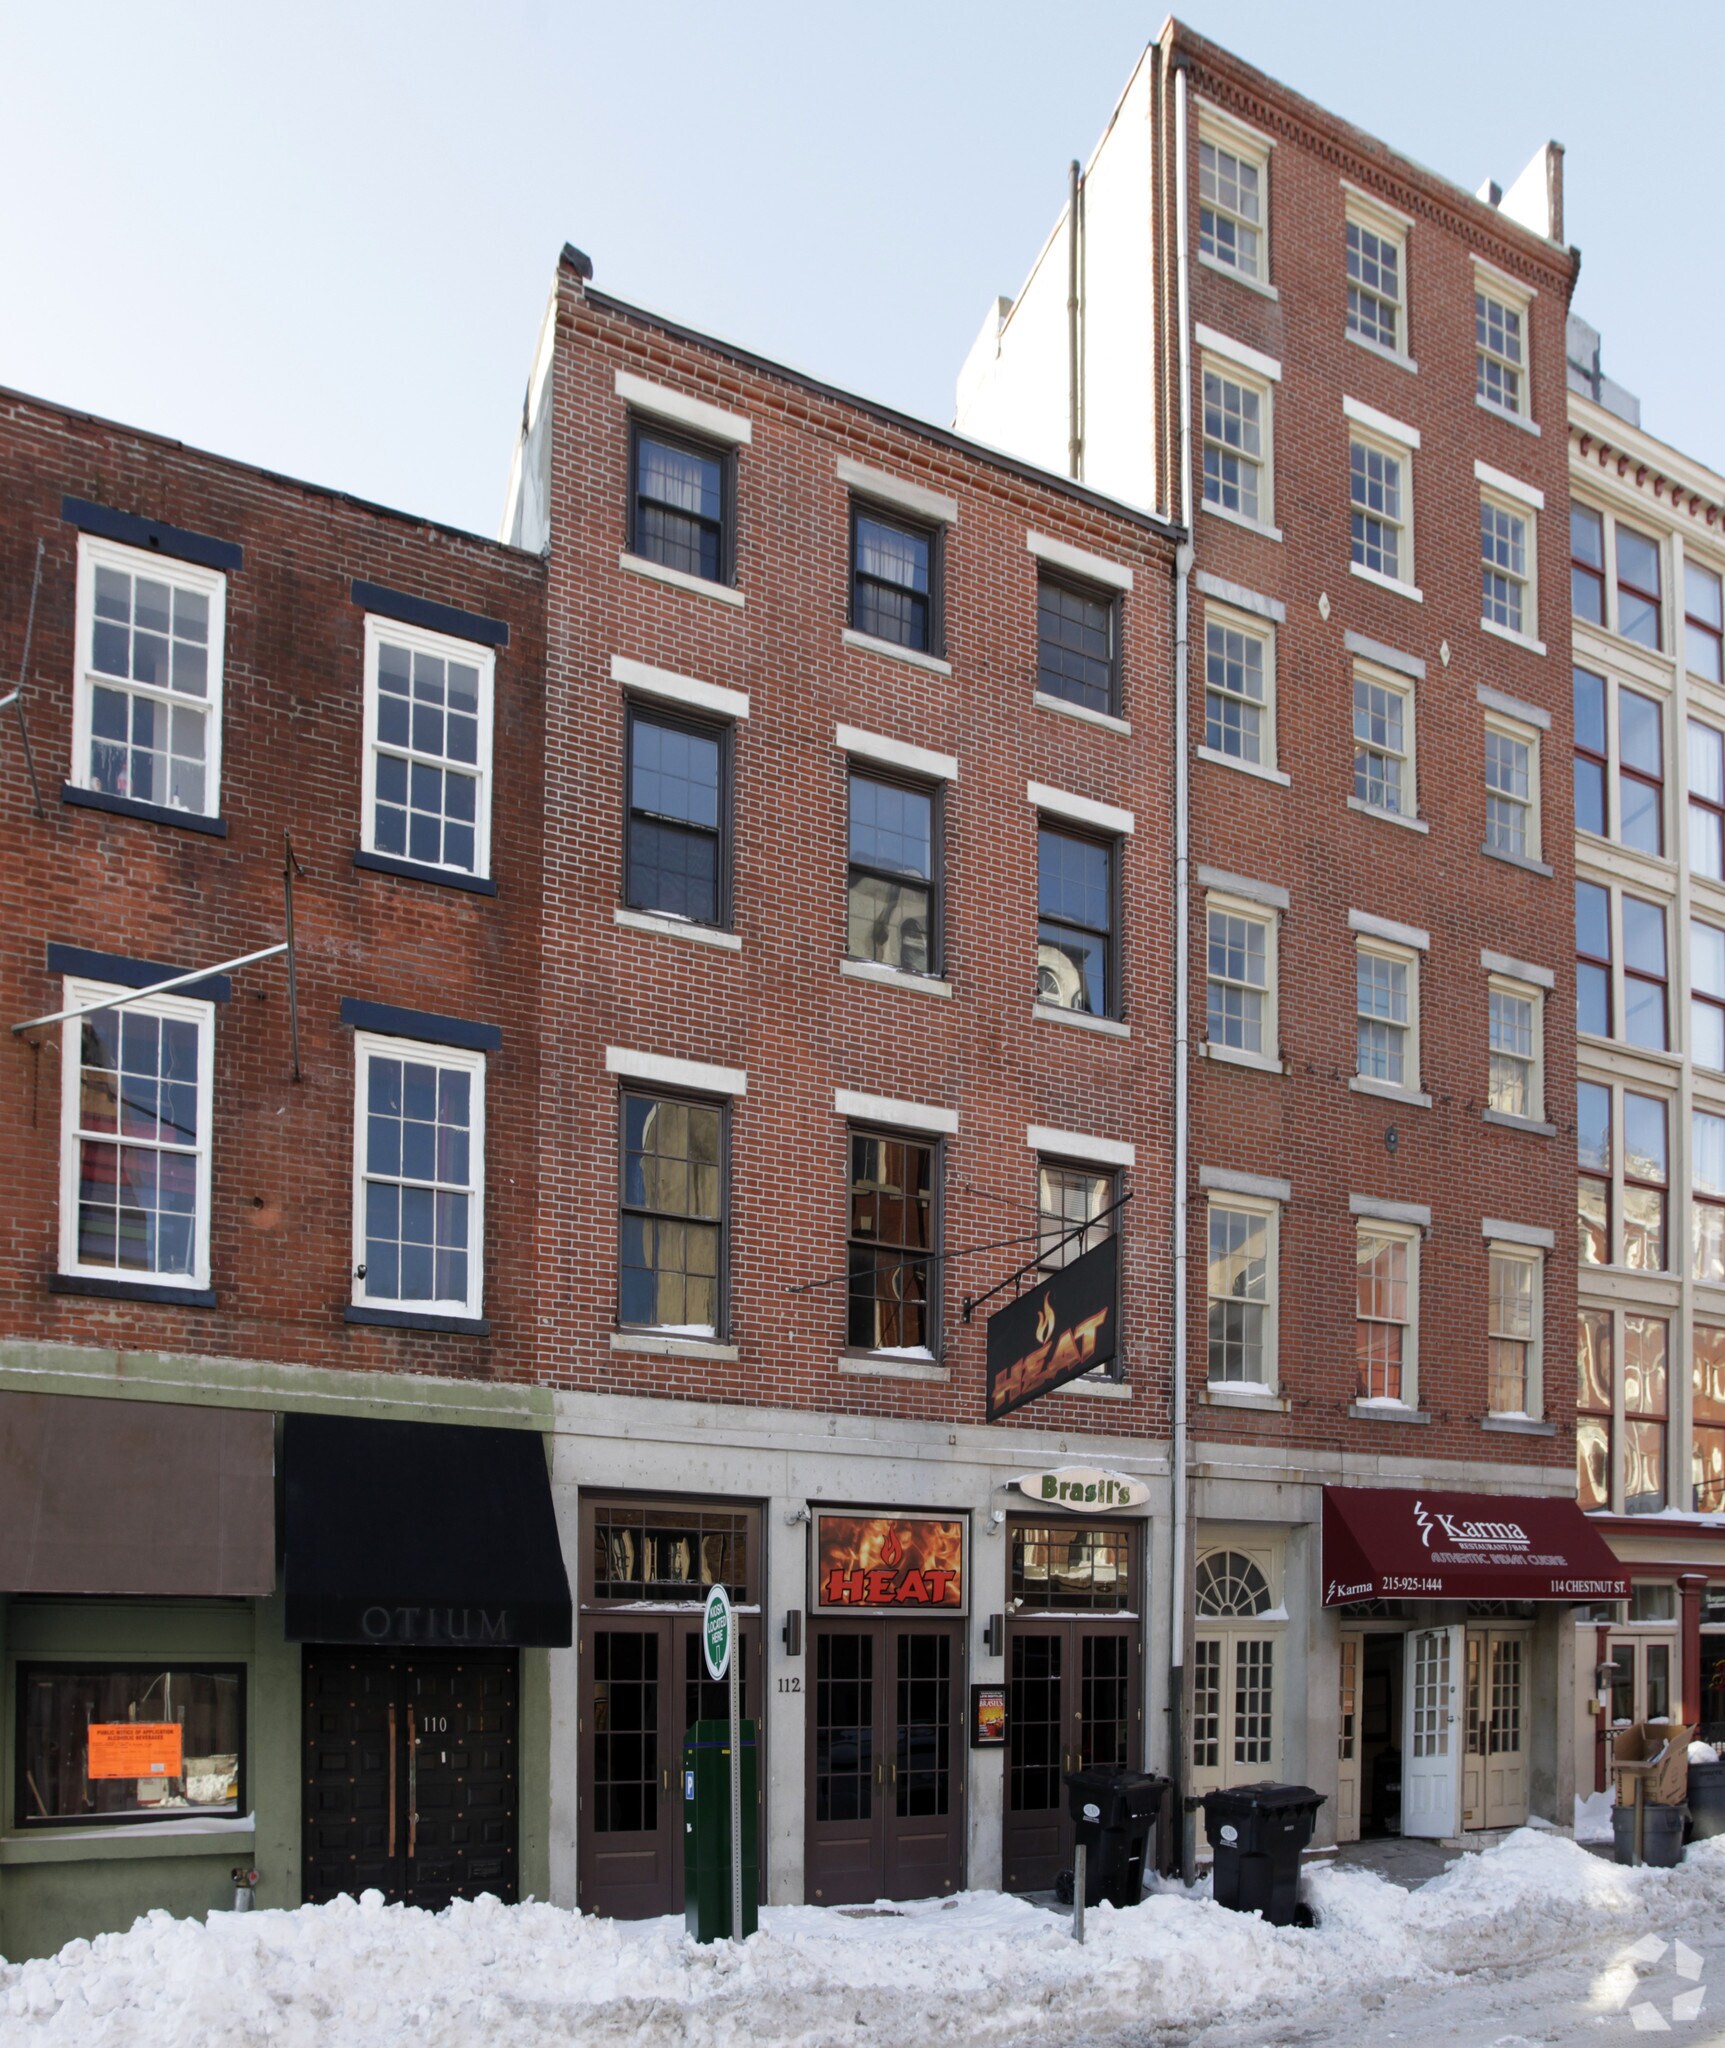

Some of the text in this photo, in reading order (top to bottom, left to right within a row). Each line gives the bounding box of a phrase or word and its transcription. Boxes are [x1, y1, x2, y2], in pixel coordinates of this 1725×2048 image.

[992, 1305, 1108, 1410] HEAT
[1041, 1474, 1130, 1505] Brasil's
[1434, 1514, 1528, 1540] Karma
[1430, 1552, 1568, 1566] AUTHENTIC INDIAN CUISINE
[825, 1568, 957, 1605] HEAT
[1337, 1582, 1373, 1597] Karma
[1382, 1576, 1443, 1591] 215-925-1444
[1551, 1580, 1627, 1594] 114 CHESTNUT ST.
[709, 1602, 724, 1617] KIOSK
[362, 1606, 509, 1640] OTIUM
[707, 1615, 727, 1634] LOCATED
[711, 1630, 724, 1645] HERE
[778, 1677, 801, 1693] 112
[424, 1716, 447, 1732] 110
[687, 1776, 693, 1795] P
